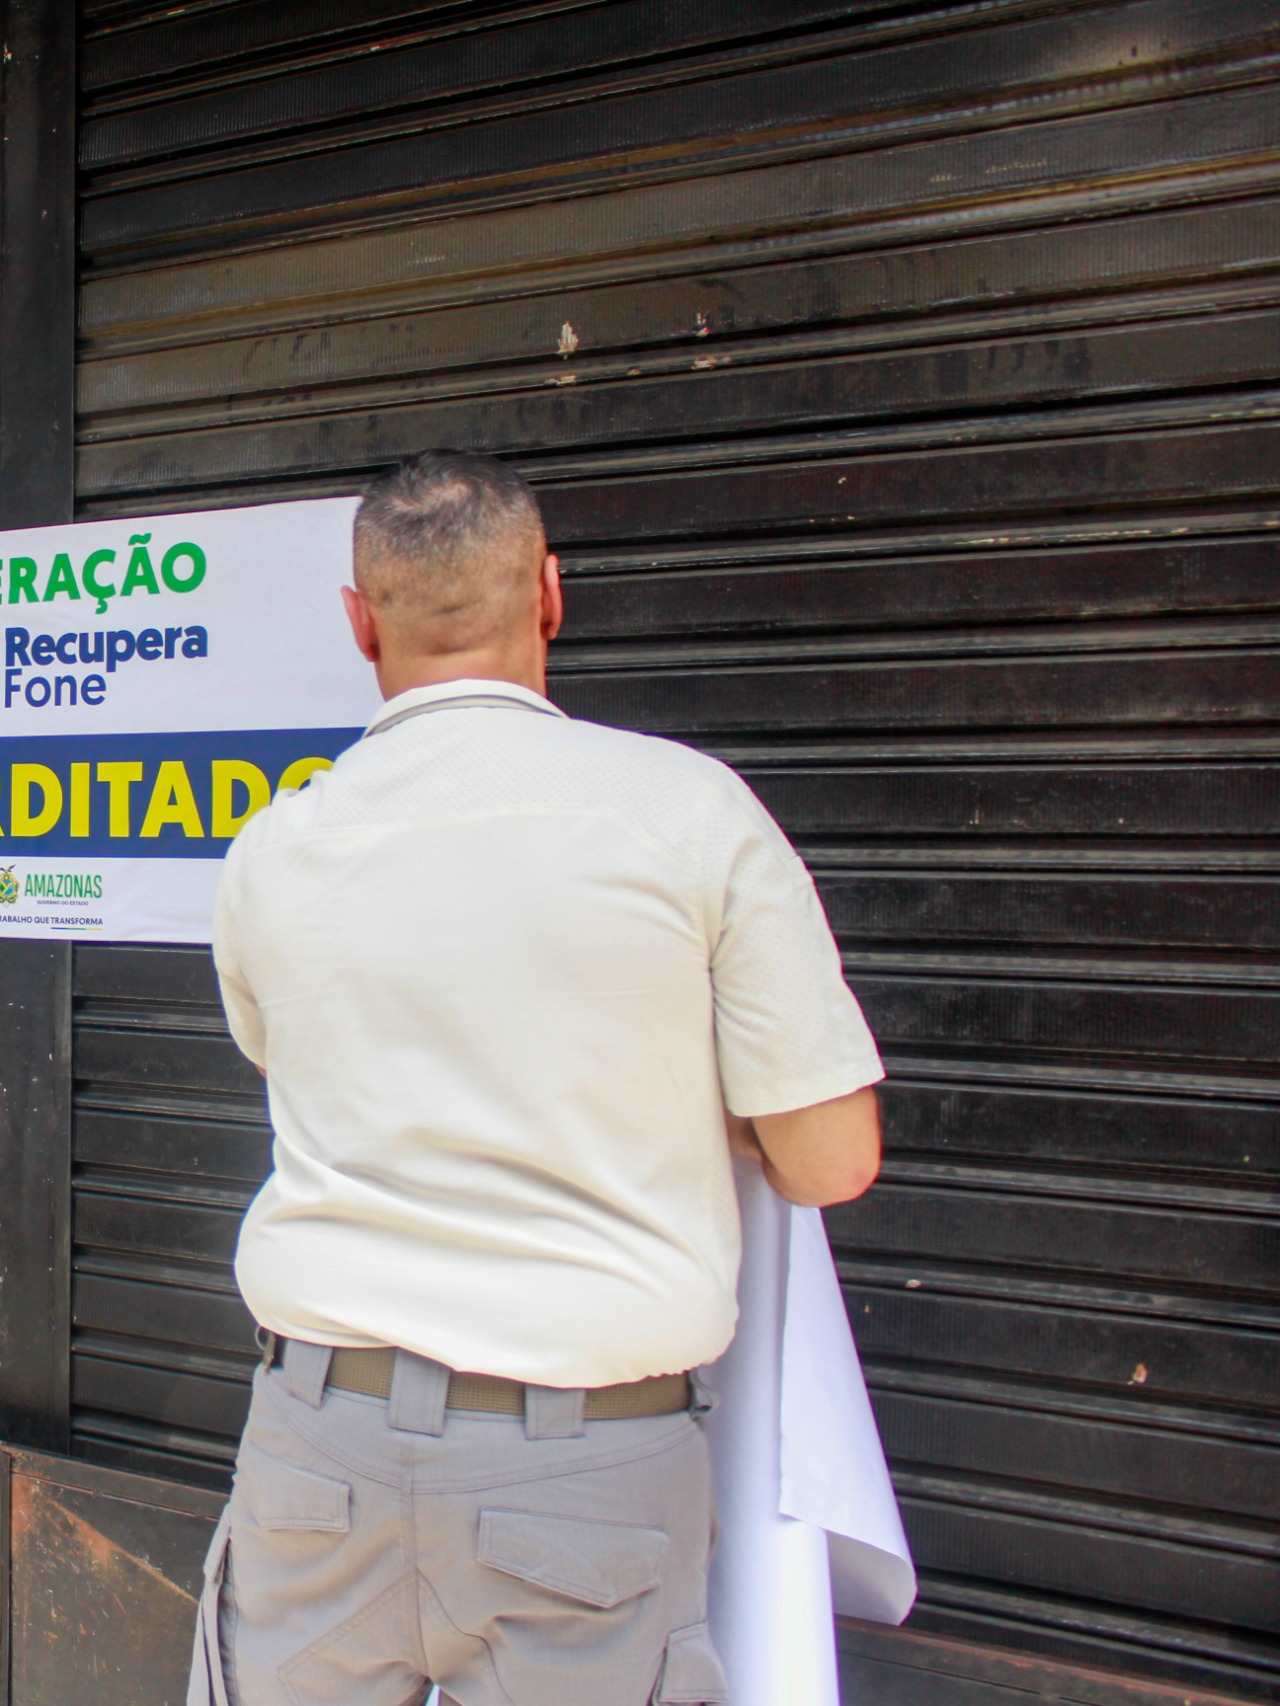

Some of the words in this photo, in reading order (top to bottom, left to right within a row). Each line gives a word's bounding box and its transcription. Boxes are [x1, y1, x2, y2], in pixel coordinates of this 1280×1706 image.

[4, 625, 208, 673] Recupera
[4, 668, 107, 708] Fone
[24, 873, 103, 899] AMAZONAS
[34, 916, 50, 924] QUE
[51, 917, 103, 926] TRANSFORMA
